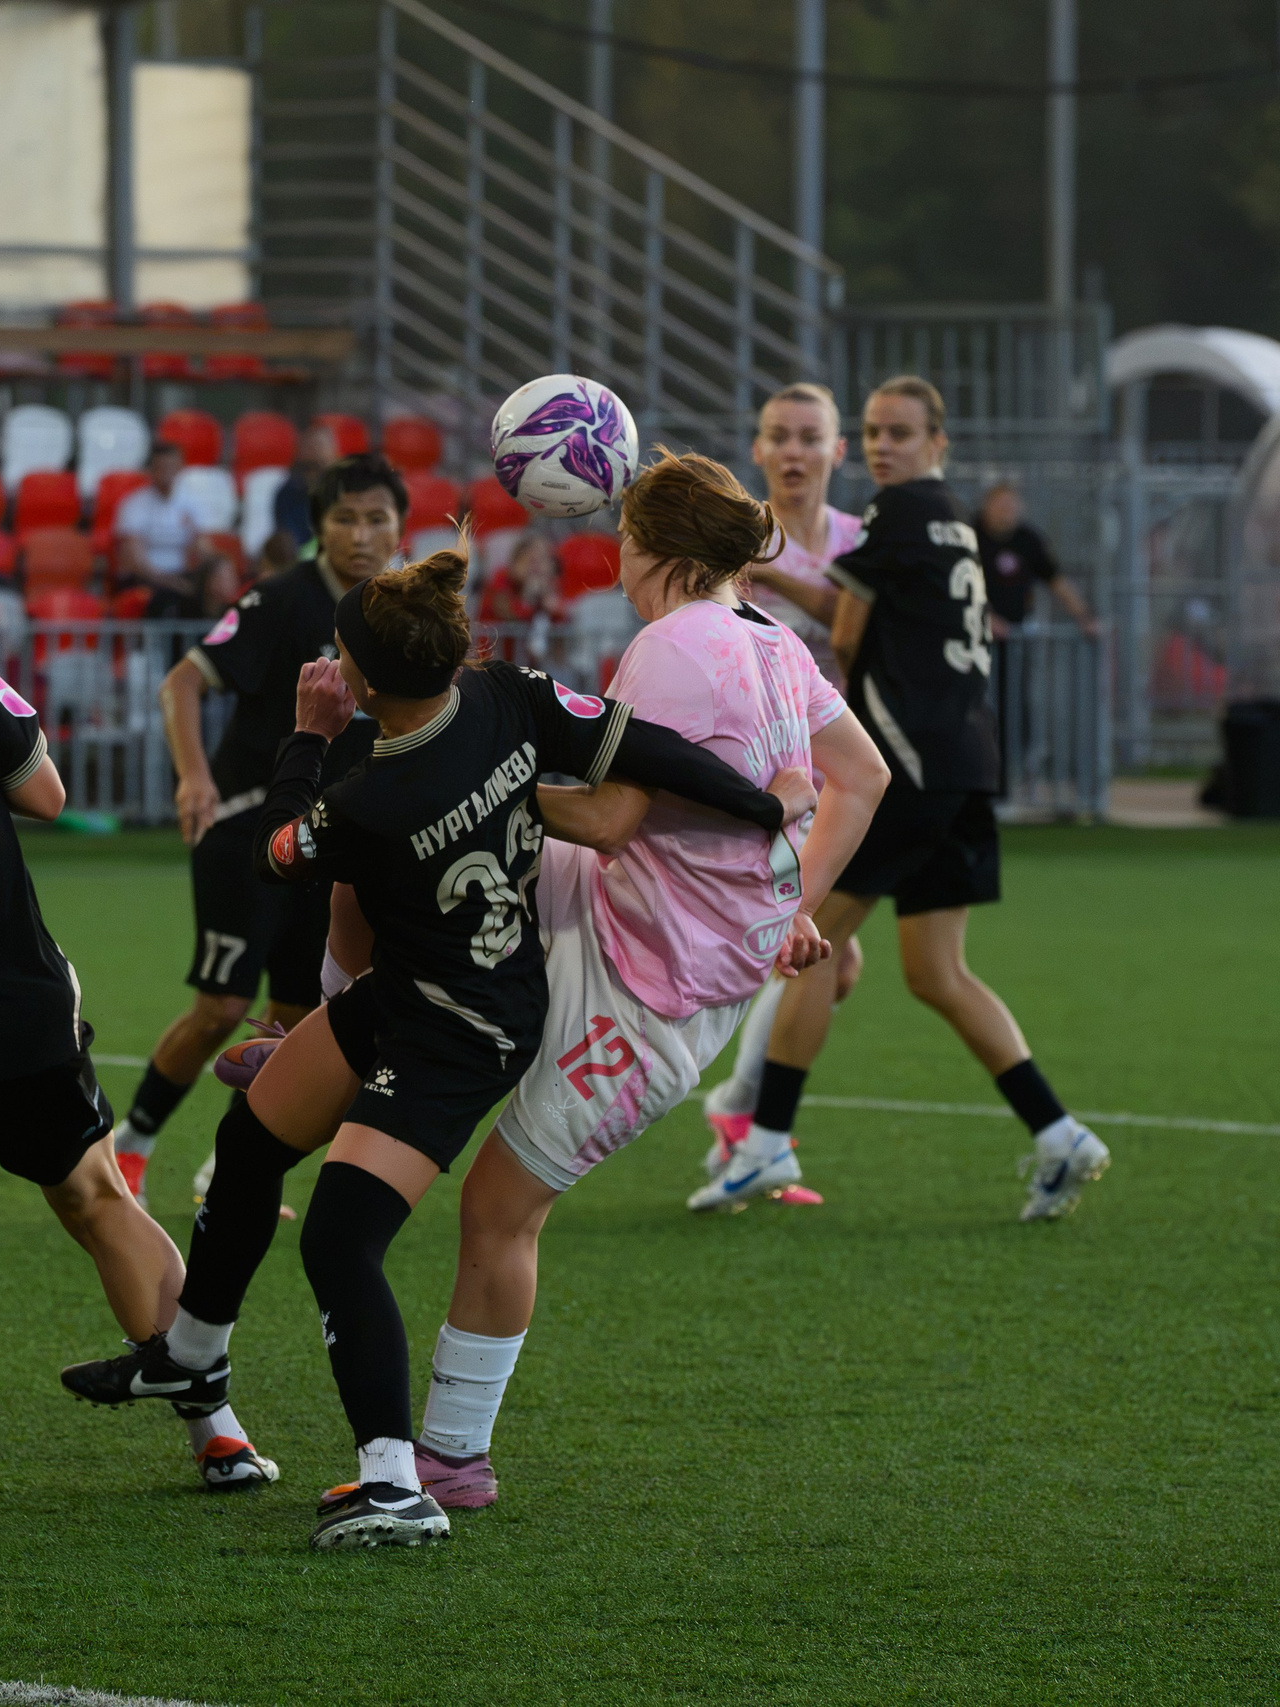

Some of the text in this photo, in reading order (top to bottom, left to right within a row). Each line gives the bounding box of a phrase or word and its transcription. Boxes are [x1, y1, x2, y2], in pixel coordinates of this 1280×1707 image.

[200, 929, 247, 985] 17
[556, 1014, 635, 1101] 12
[364, 1082, 395, 1097] KELME
